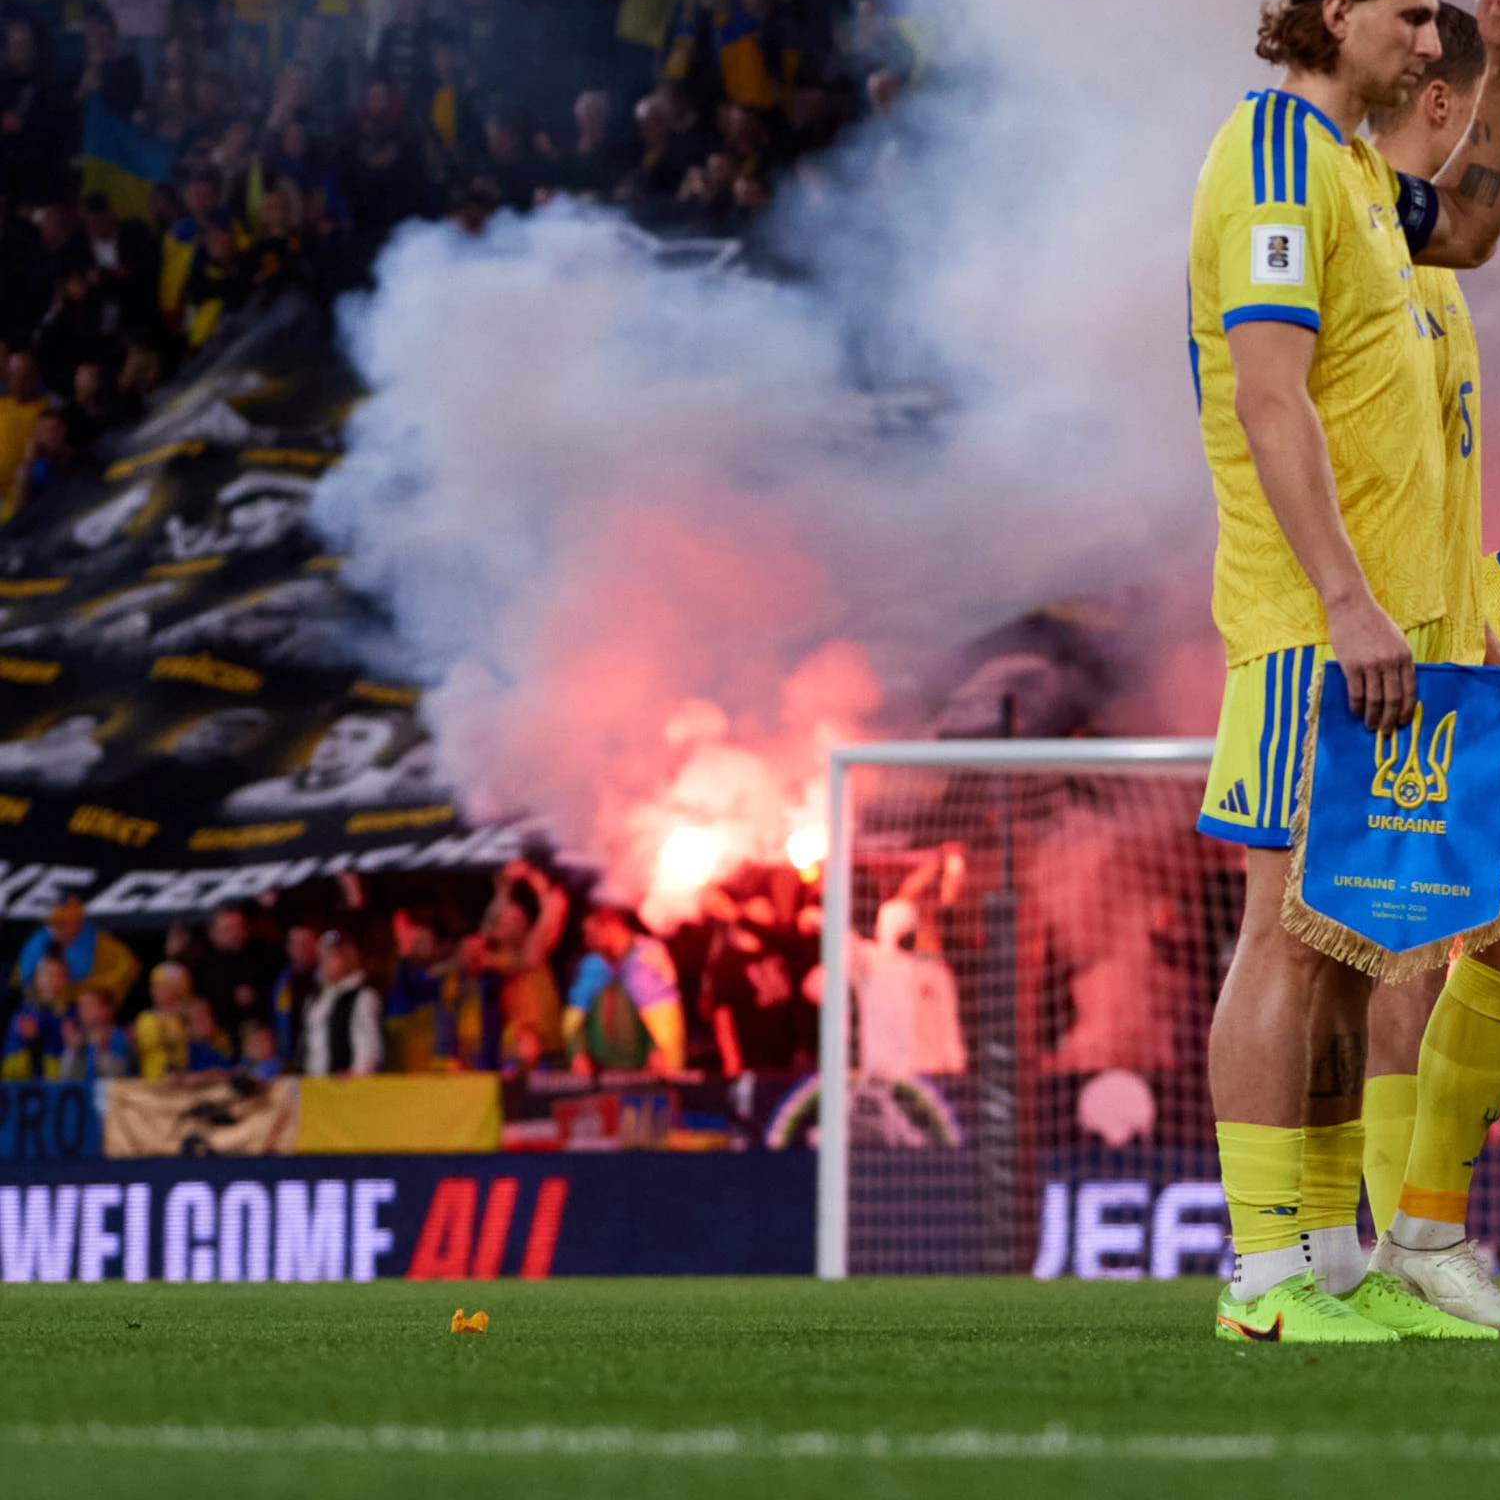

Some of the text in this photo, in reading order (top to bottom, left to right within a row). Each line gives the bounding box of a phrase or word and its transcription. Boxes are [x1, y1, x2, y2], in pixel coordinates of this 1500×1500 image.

[1367, 814, 1447, 834] UKRAINE
[1333, 875, 1396, 891] UKRAINE
[1410, 881, 1471, 897] SWEDEN
